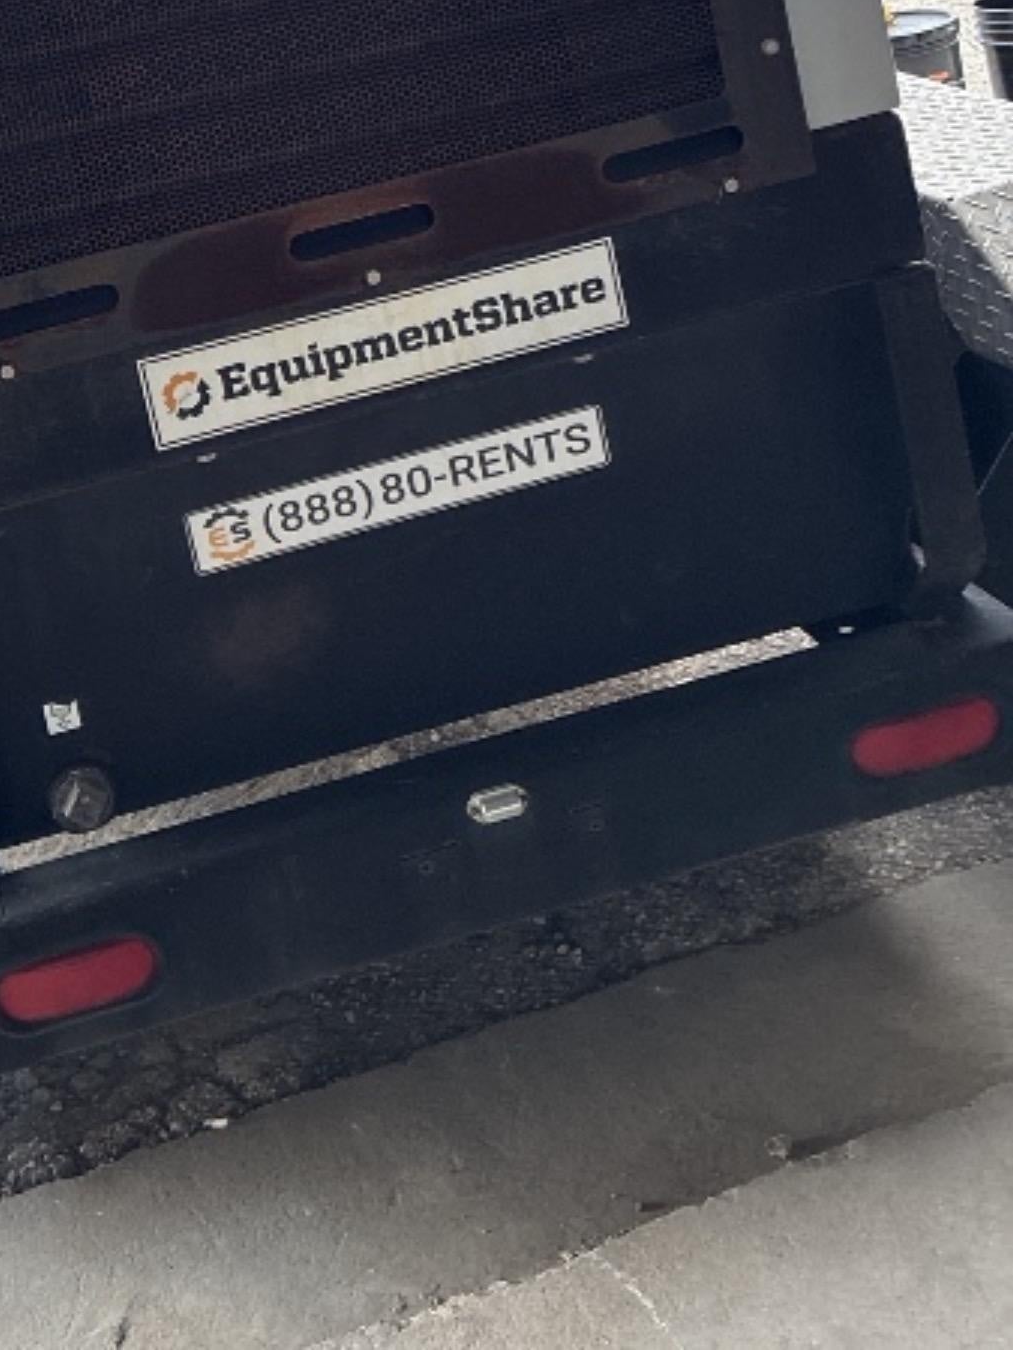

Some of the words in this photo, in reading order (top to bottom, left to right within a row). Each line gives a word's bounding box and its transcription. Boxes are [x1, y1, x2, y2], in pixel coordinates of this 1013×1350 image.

[216, 277, 606, 399] EquipmentShare
[262, 478, 374, 543] (888)
[381, 423, 591, 505] 80-RENTS
